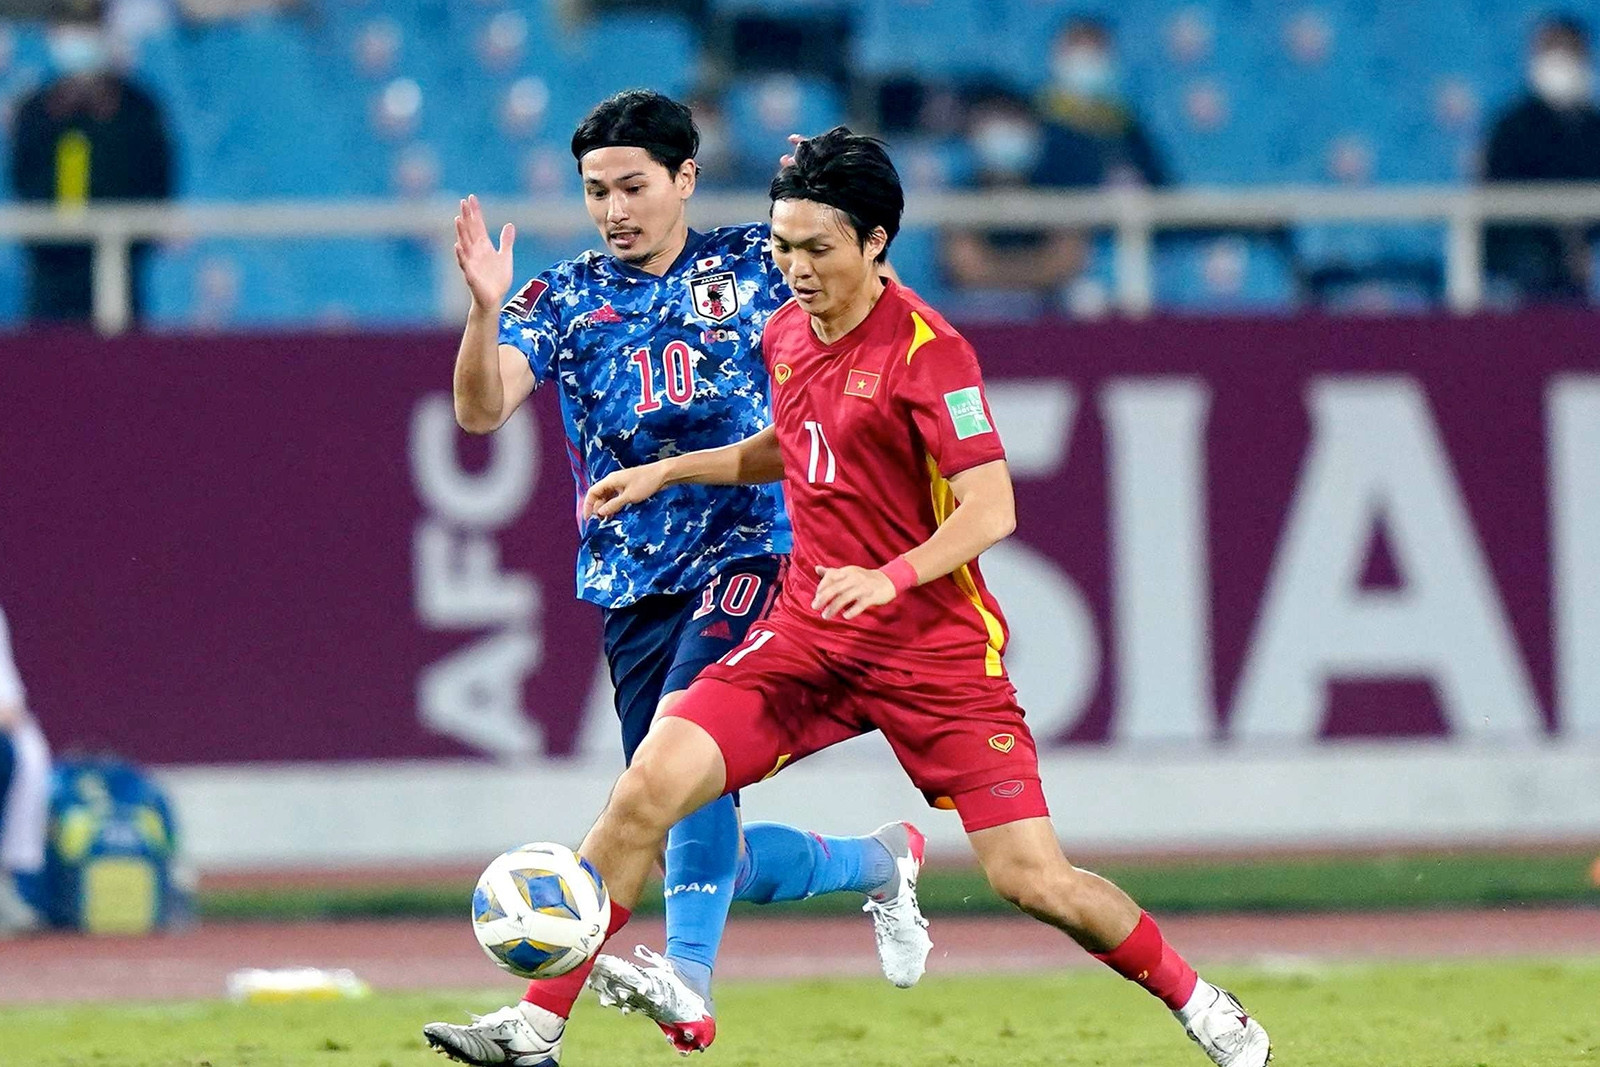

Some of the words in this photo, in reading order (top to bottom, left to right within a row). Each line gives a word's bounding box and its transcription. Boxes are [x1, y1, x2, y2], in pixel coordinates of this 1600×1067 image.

[631, 340, 696, 415] 10
[803, 420, 836, 484] 11
[692, 573, 762, 621] 10
[664, 882, 718, 898] APAN
